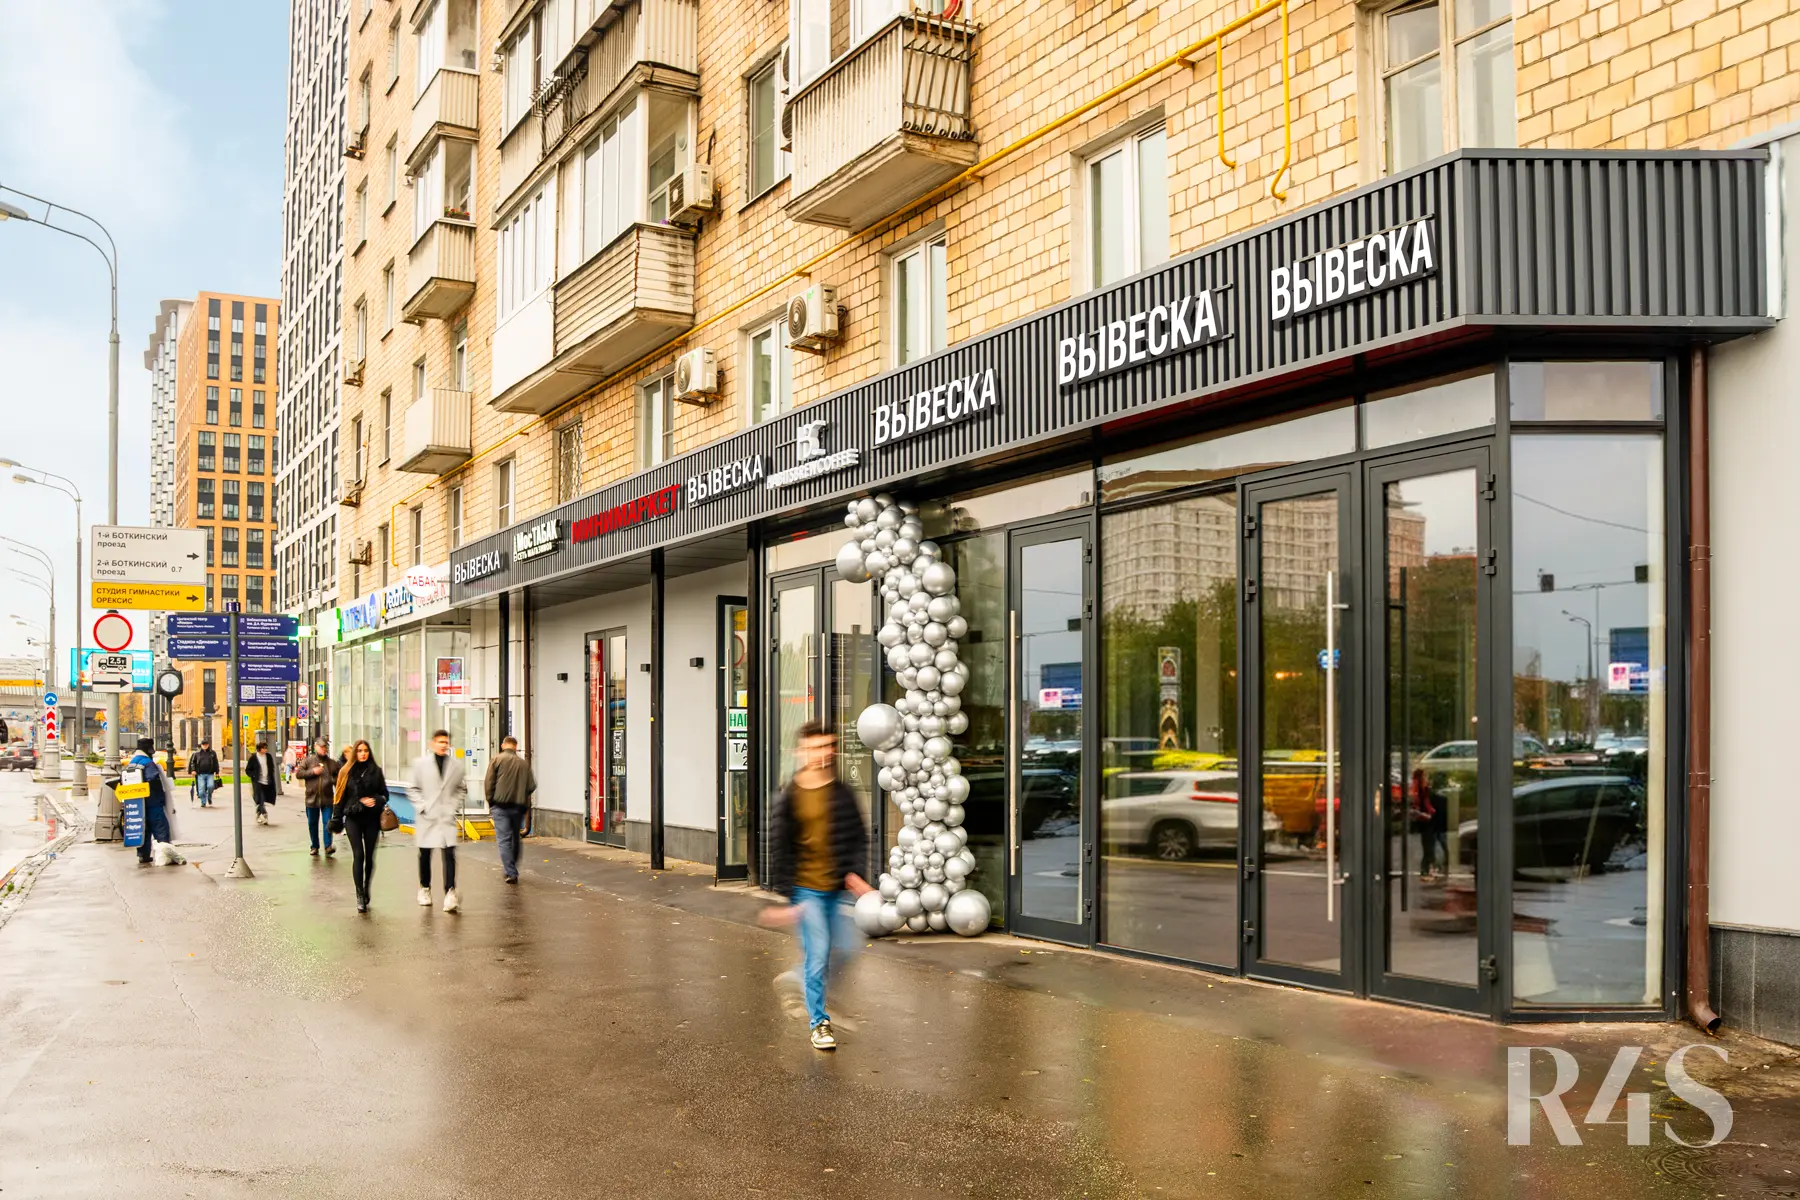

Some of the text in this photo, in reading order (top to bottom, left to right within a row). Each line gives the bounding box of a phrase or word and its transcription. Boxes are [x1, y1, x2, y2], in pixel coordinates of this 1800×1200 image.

[1270, 219, 1434, 321] ВЫВЕСКА
[1059, 288, 1218, 386] ВЫВЕСКА
[874, 368, 998, 447] ВЫВЕСКА
[687, 454, 764, 504] ВЫВЕСКА
[571, 483, 681, 545] МИНИМАРКЕТ
[97, 531, 168, 541] 1-й БОТКИНСКИЙ
[96, 559, 168, 568] 2-й БОТКИНСКИЙ
[96, 568, 126, 576] проезд
[407, 575, 436, 587] ТАБАК
[454, 549, 501, 584] ВЫВЕСКА
[96, 587, 180, 596] СТУДИЯ ГИМНАСТИКИ
